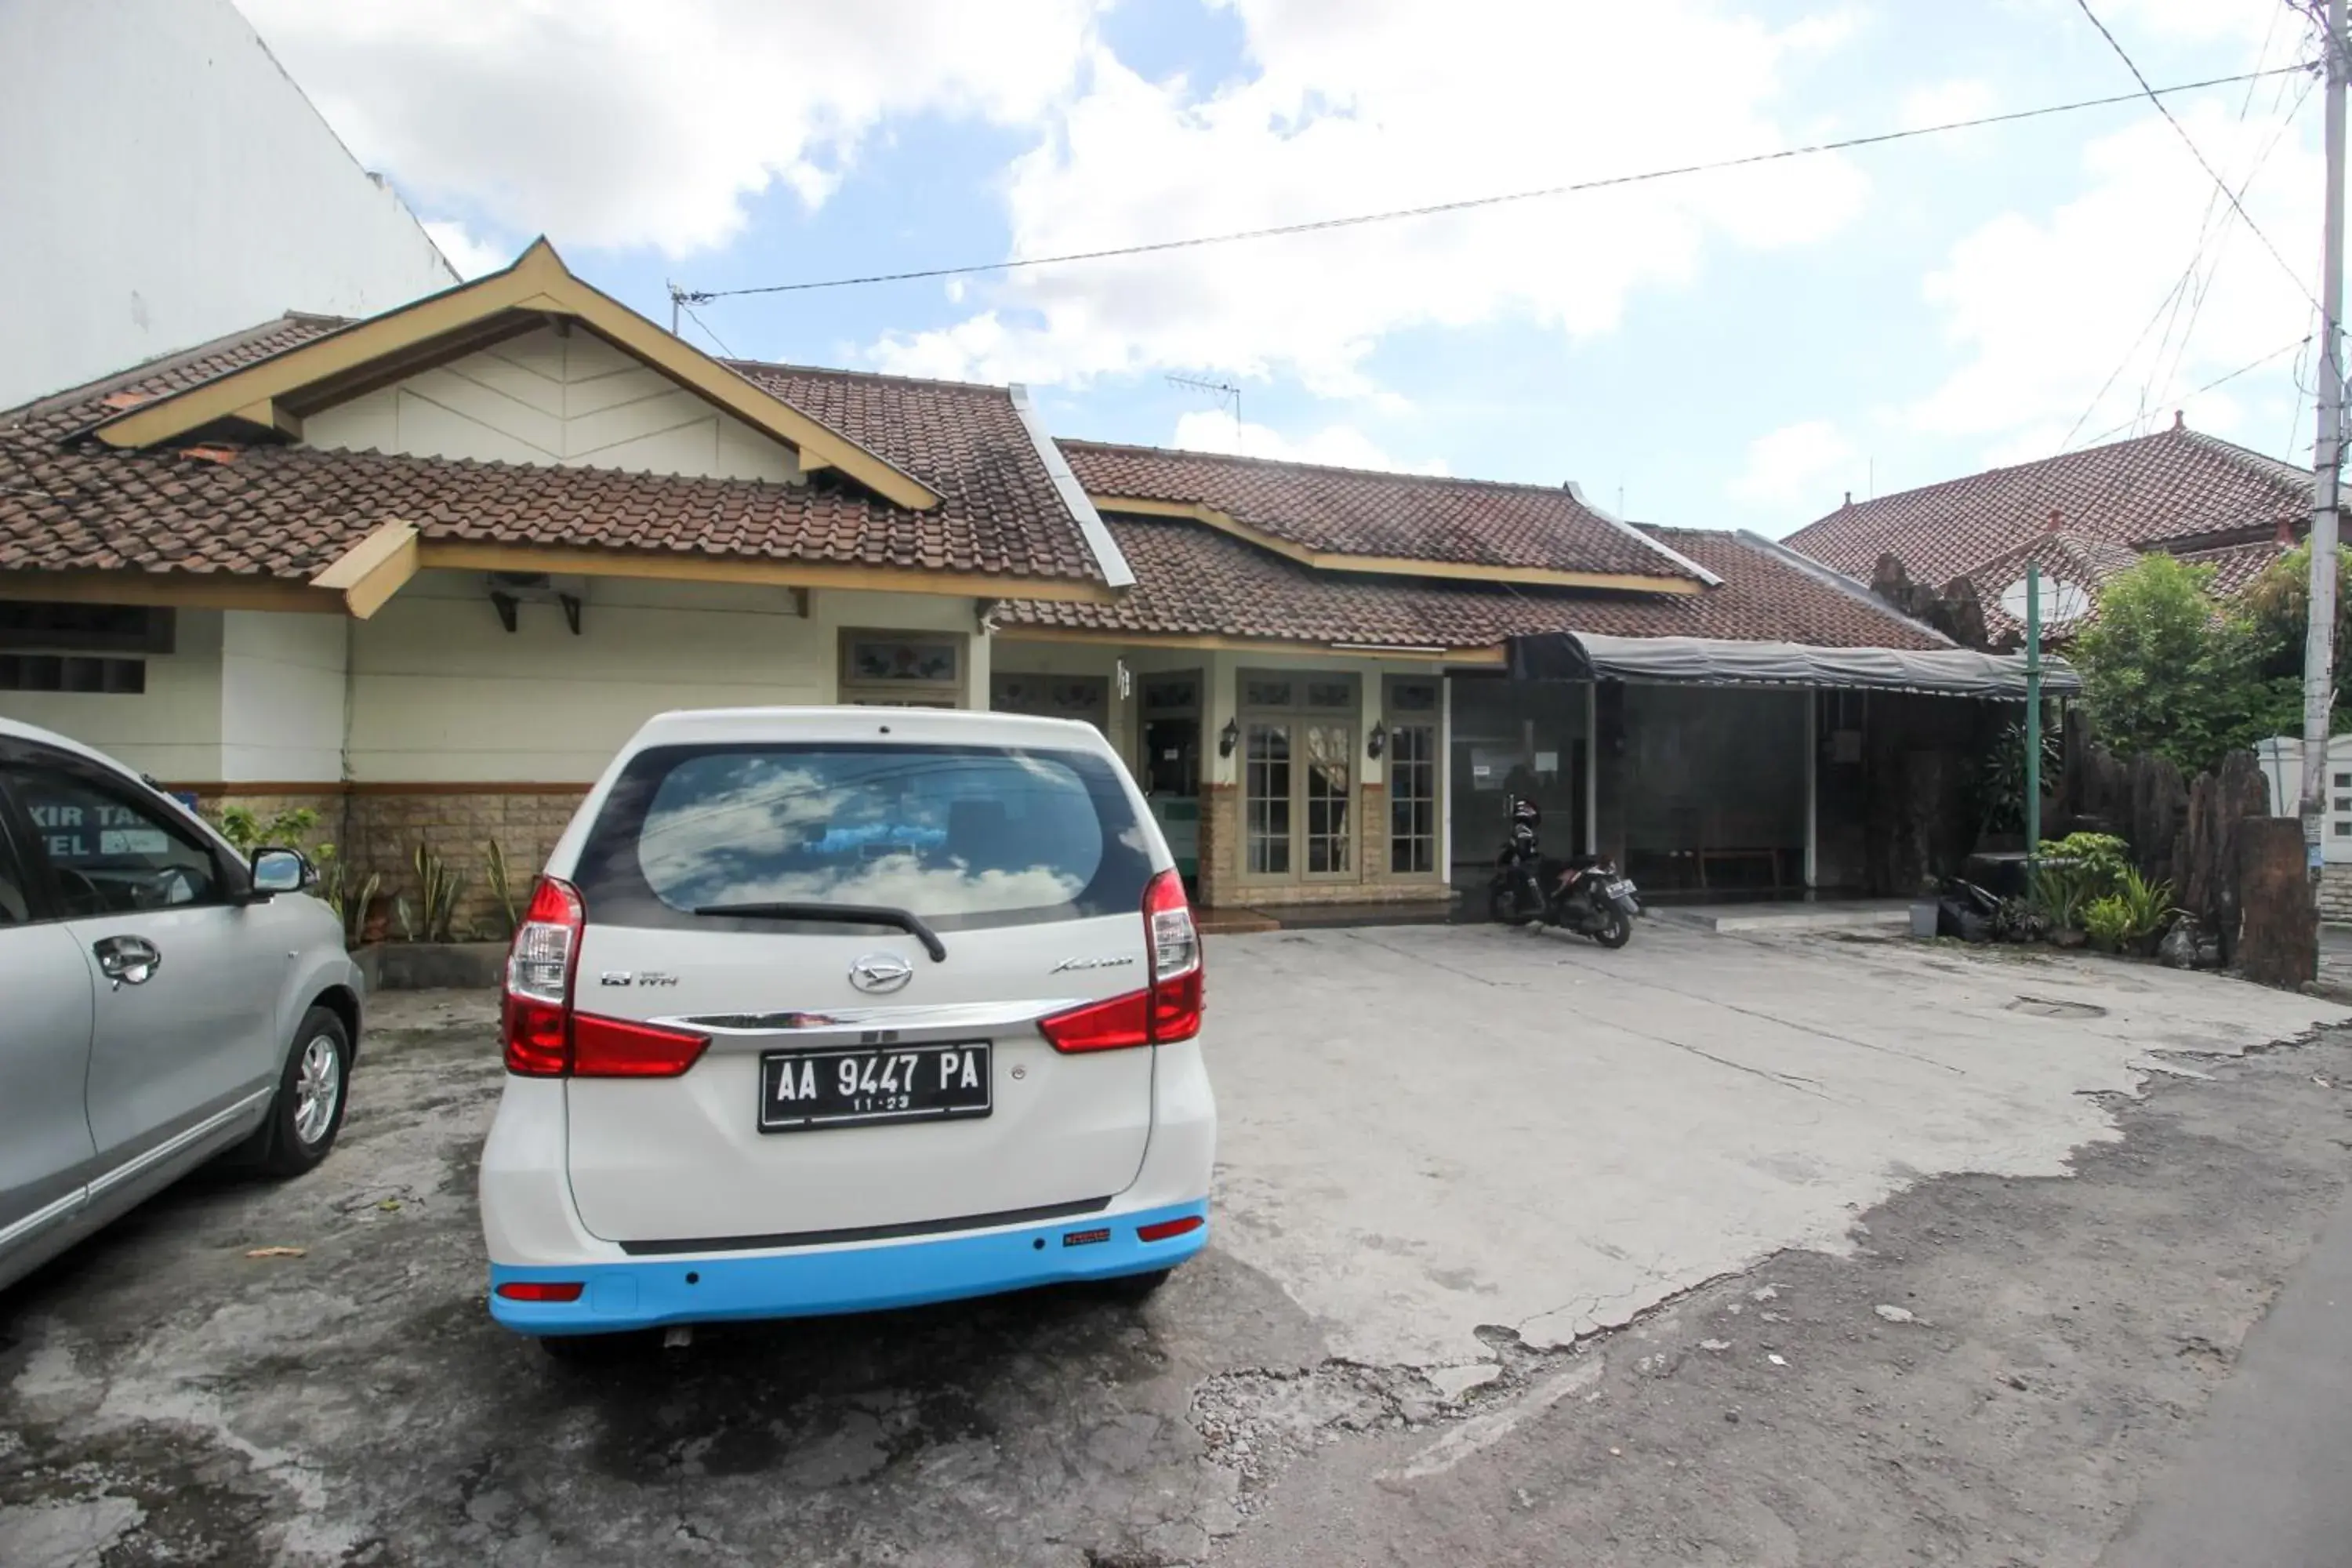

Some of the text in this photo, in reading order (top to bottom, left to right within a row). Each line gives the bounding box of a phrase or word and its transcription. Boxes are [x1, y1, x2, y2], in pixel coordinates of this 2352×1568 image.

[95, 806, 147, 826] TA
[41, 834, 90, 856] EL
[777, 1051, 978, 1101] AA 9447 PA
